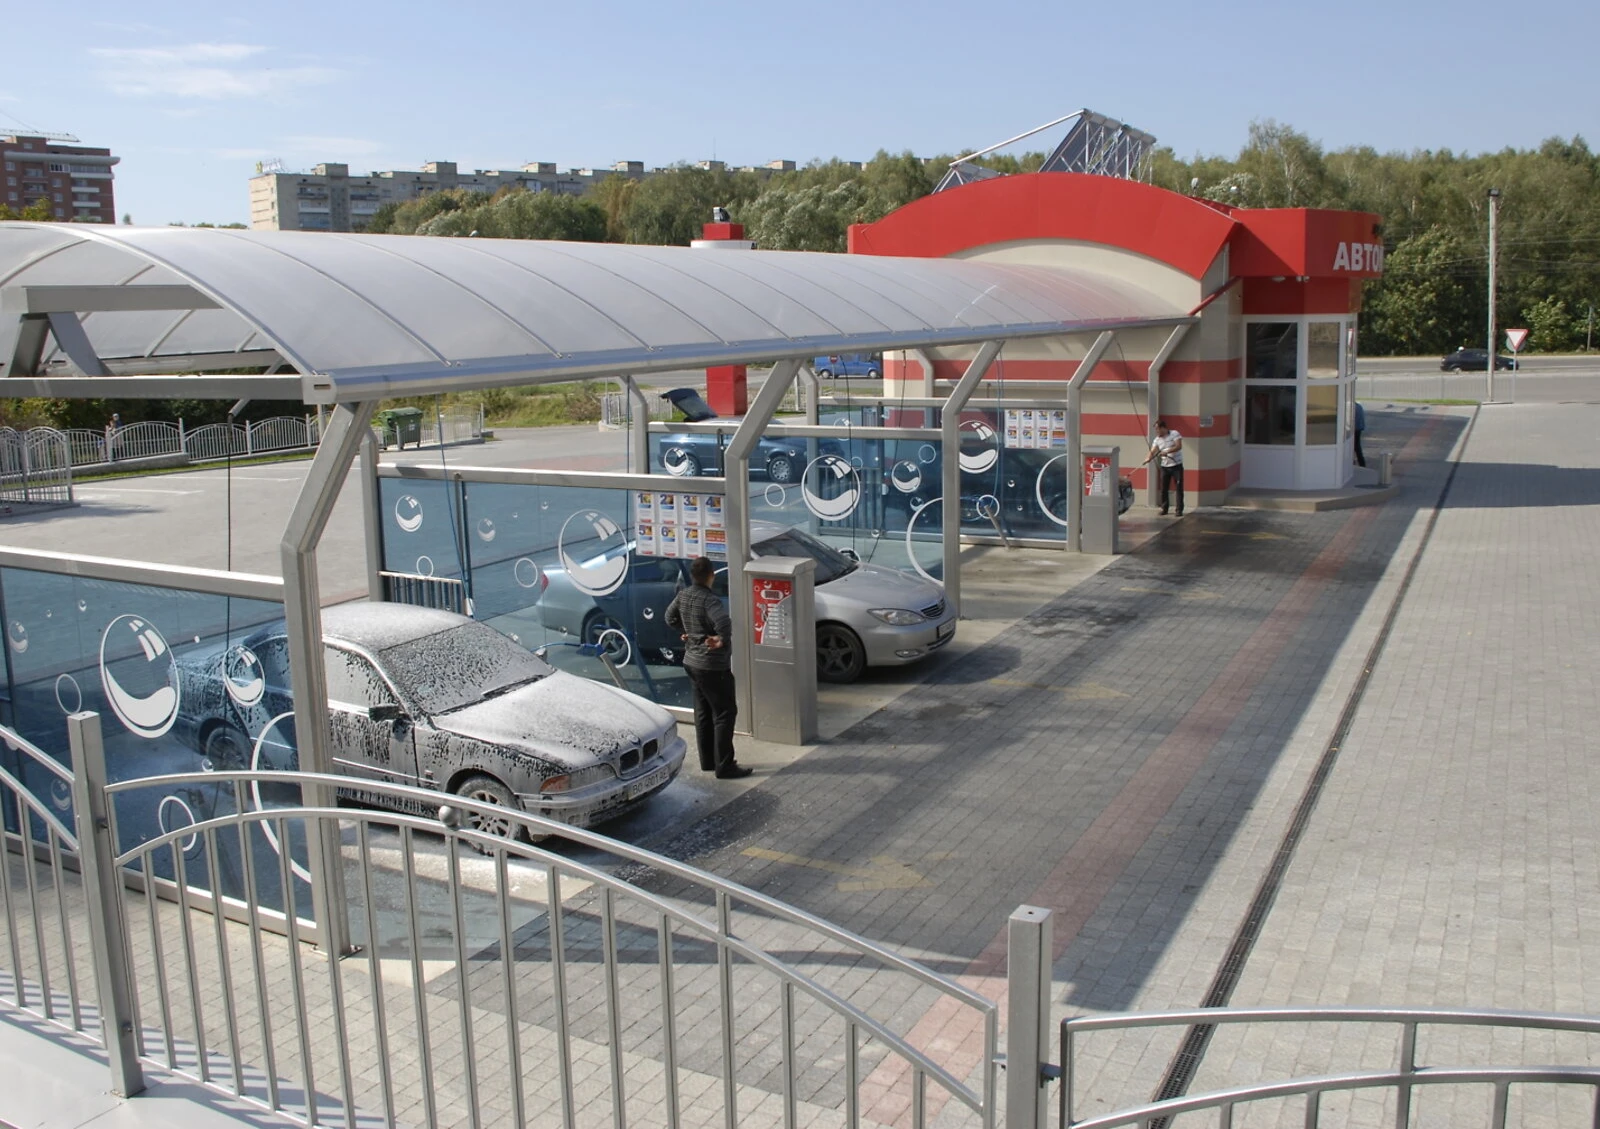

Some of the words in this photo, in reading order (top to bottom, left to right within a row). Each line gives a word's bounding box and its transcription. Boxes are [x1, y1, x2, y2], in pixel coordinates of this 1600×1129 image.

[638, 493, 643, 504] 1
[660, 494, 667, 505] 2
[683, 495, 691, 506] 3
[705, 496, 713, 507] 4
[639, 525, 646, 535] 5
[661, 526, 668, 537] 6
[684, 527, 691, 538] 7
